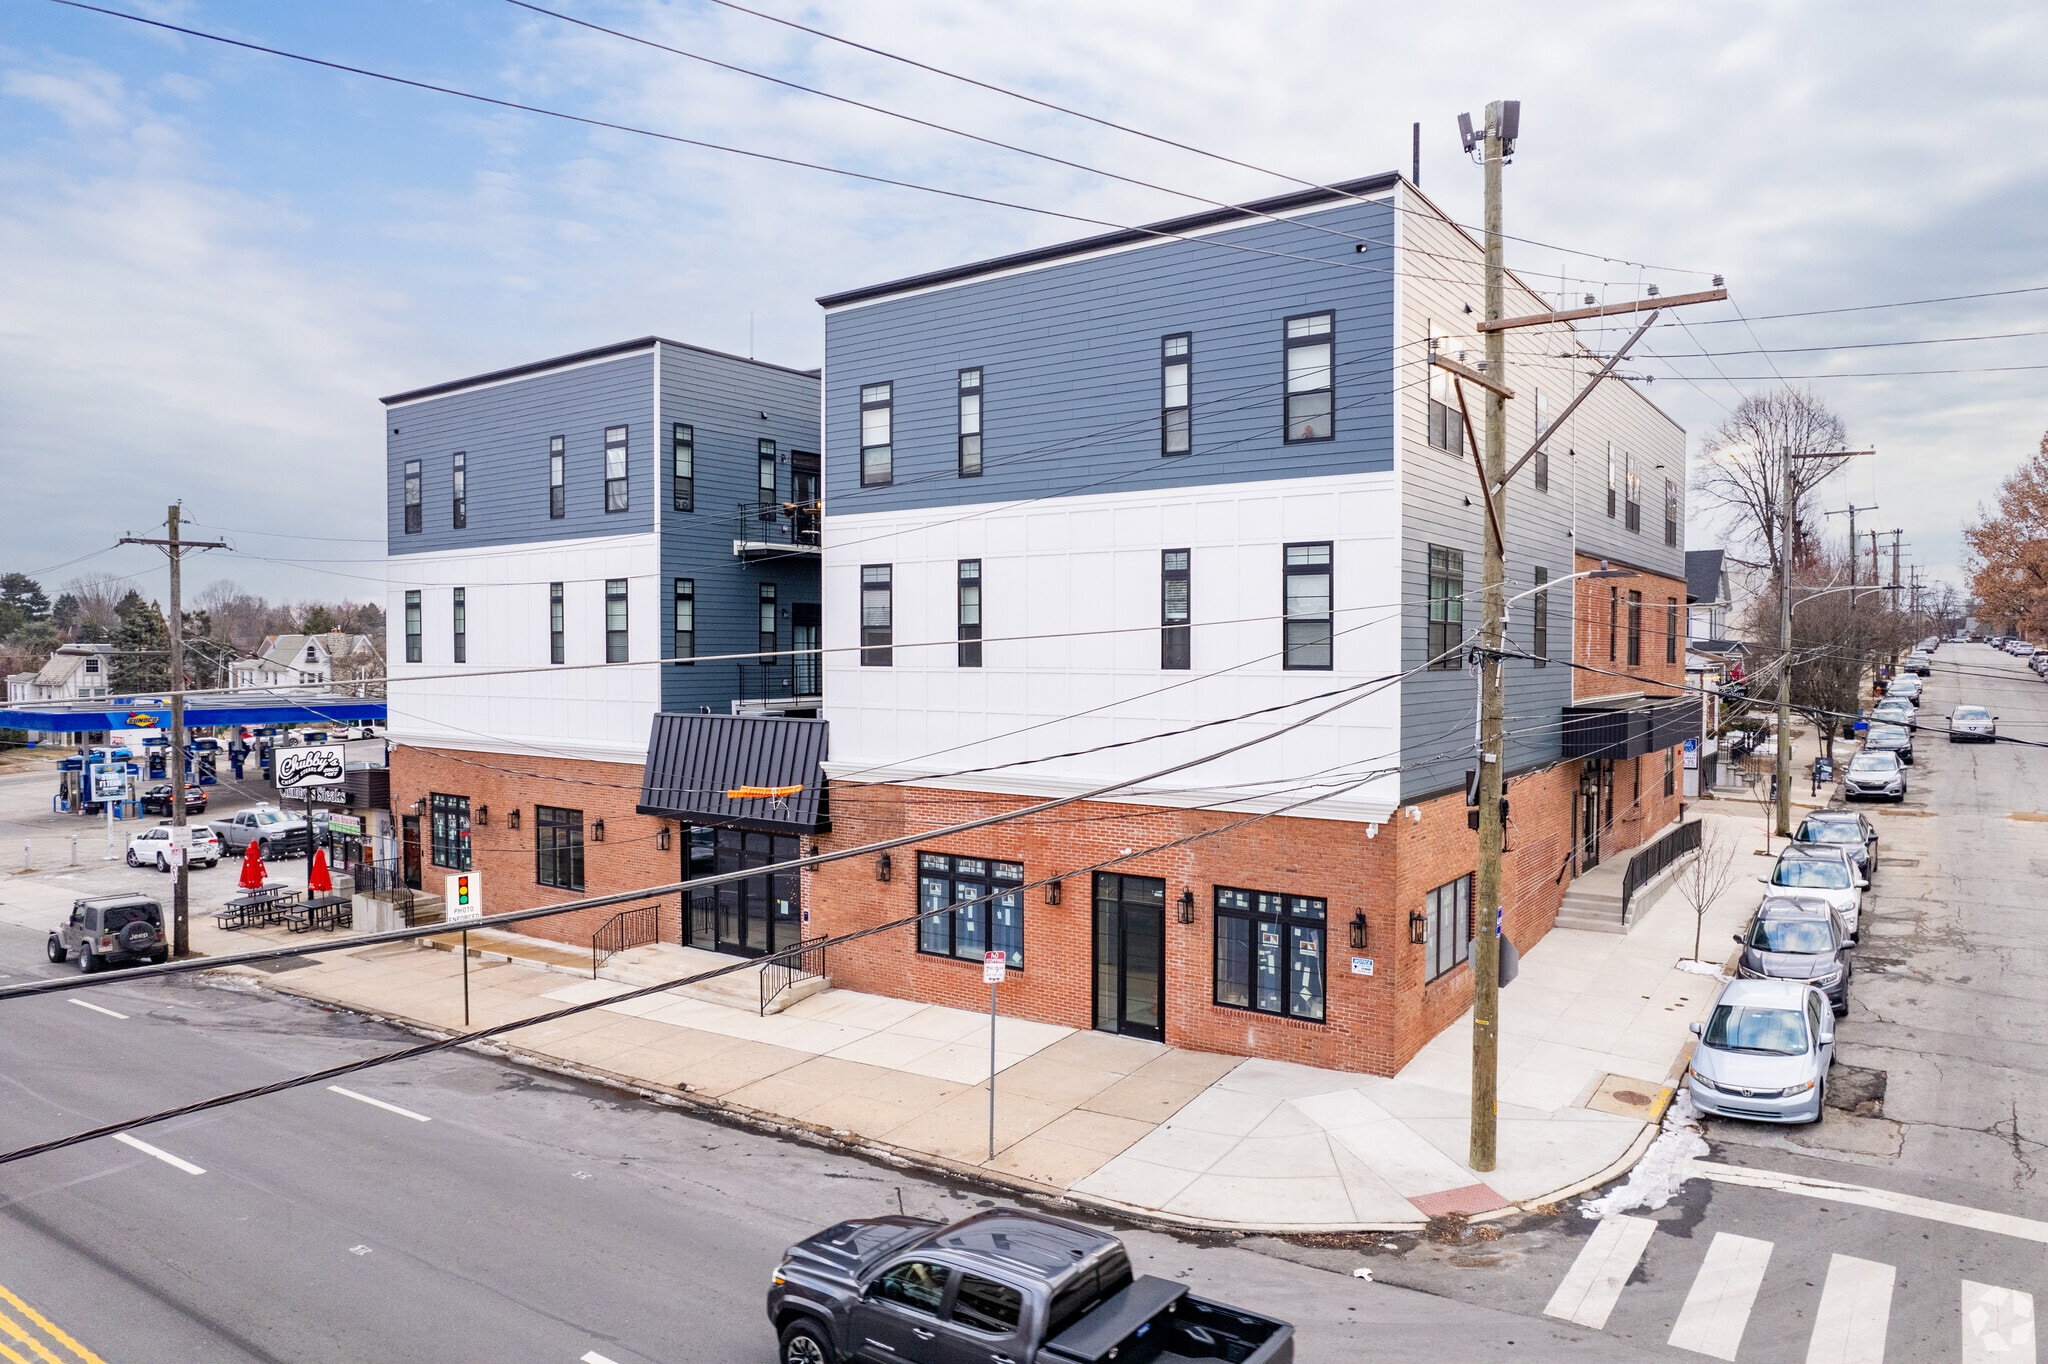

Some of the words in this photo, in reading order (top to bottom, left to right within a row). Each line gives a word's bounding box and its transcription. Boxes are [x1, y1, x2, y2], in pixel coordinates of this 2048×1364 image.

[280, 751, 340, 778] Chubby's
[317, 787, 346, 804] Steaks
[454, 906, 475, 914] PHOTO
[130, 932, 149, 940] Jeep
